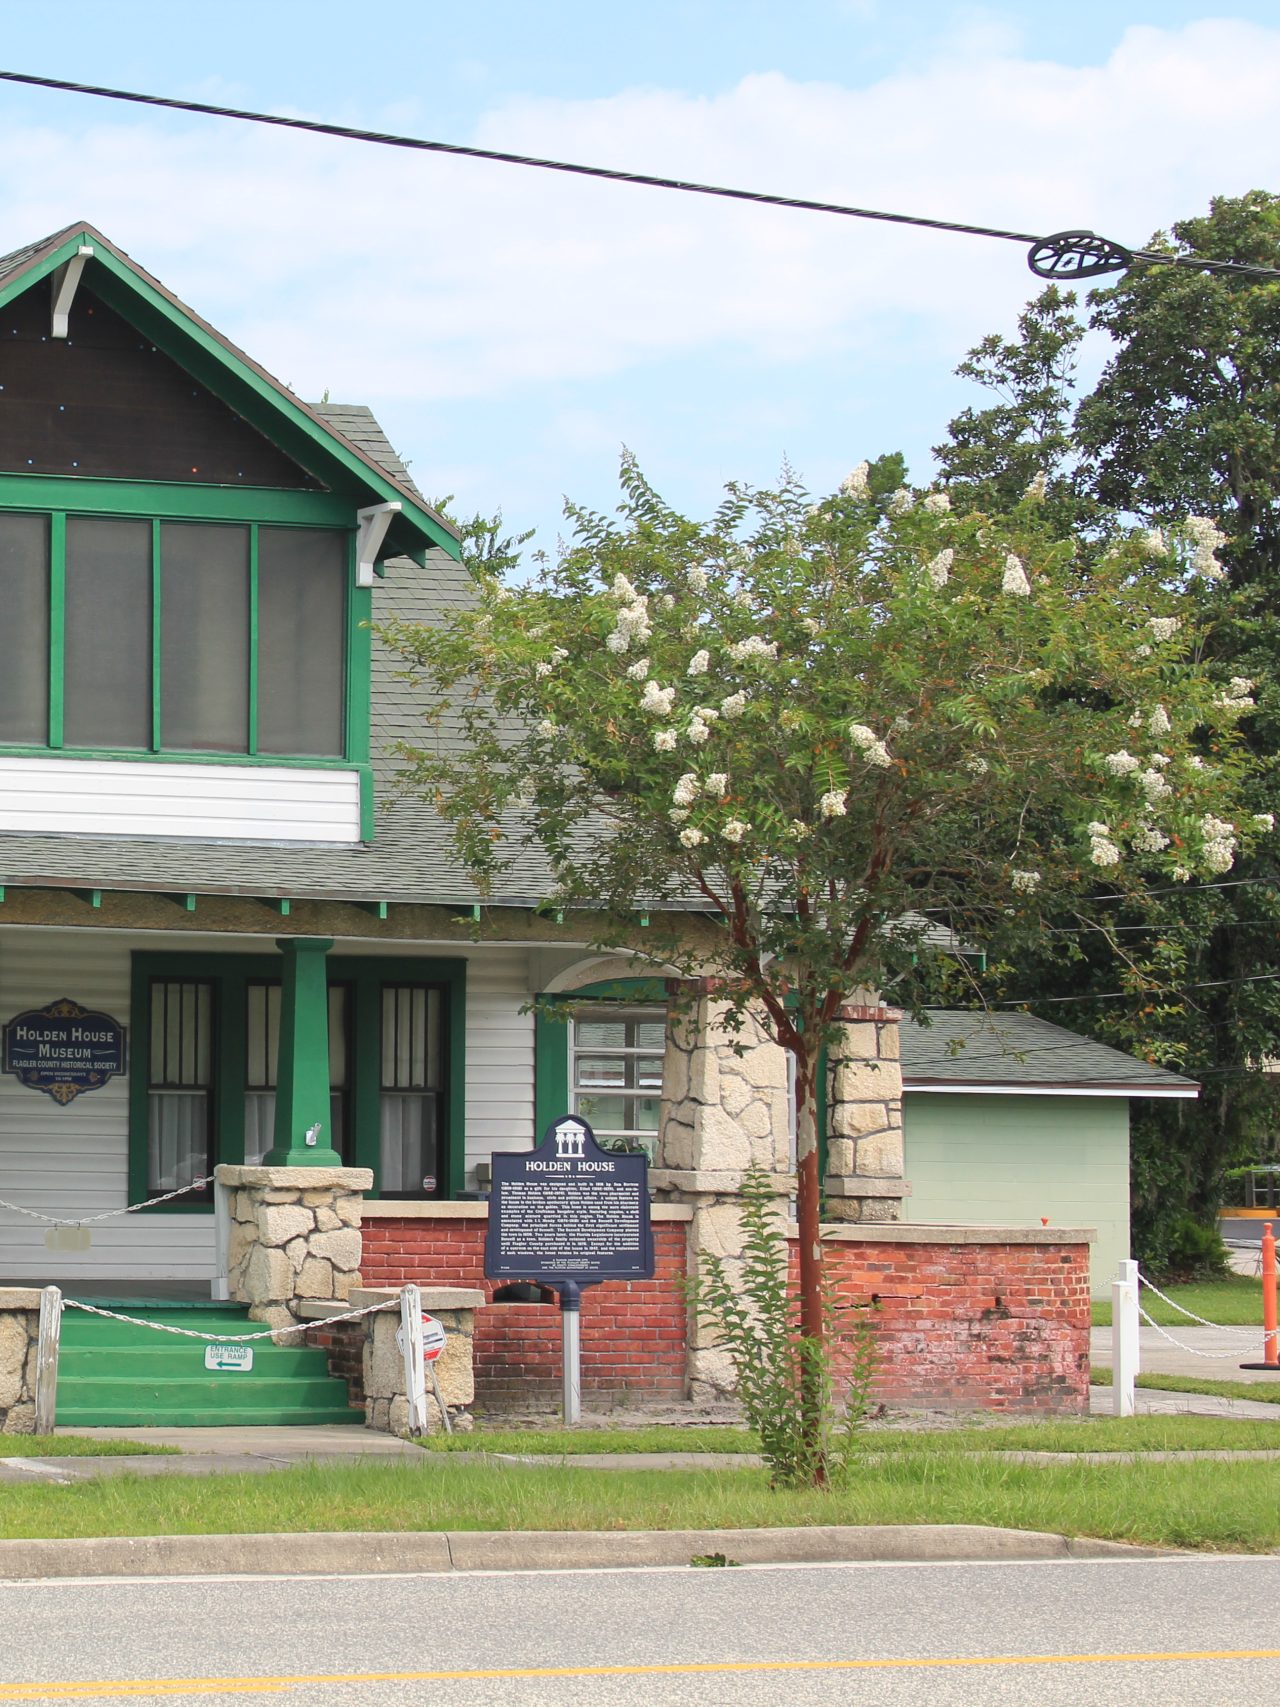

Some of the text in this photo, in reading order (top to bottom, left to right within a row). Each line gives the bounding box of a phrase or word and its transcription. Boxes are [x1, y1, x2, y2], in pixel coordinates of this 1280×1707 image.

[16, 1026, 114, 1042] HOLDEN HOUSE
[38, 1044, 91, 1058] MUSEUM
[12, 1060, 38, 1068] FLAGLER
[61, 1061, 93, 1069] HISTORICAL
[94, 1062, 117, 1070] SOCIETY
[525, 1161, 616, 1172] HOLDEN HOUSE
